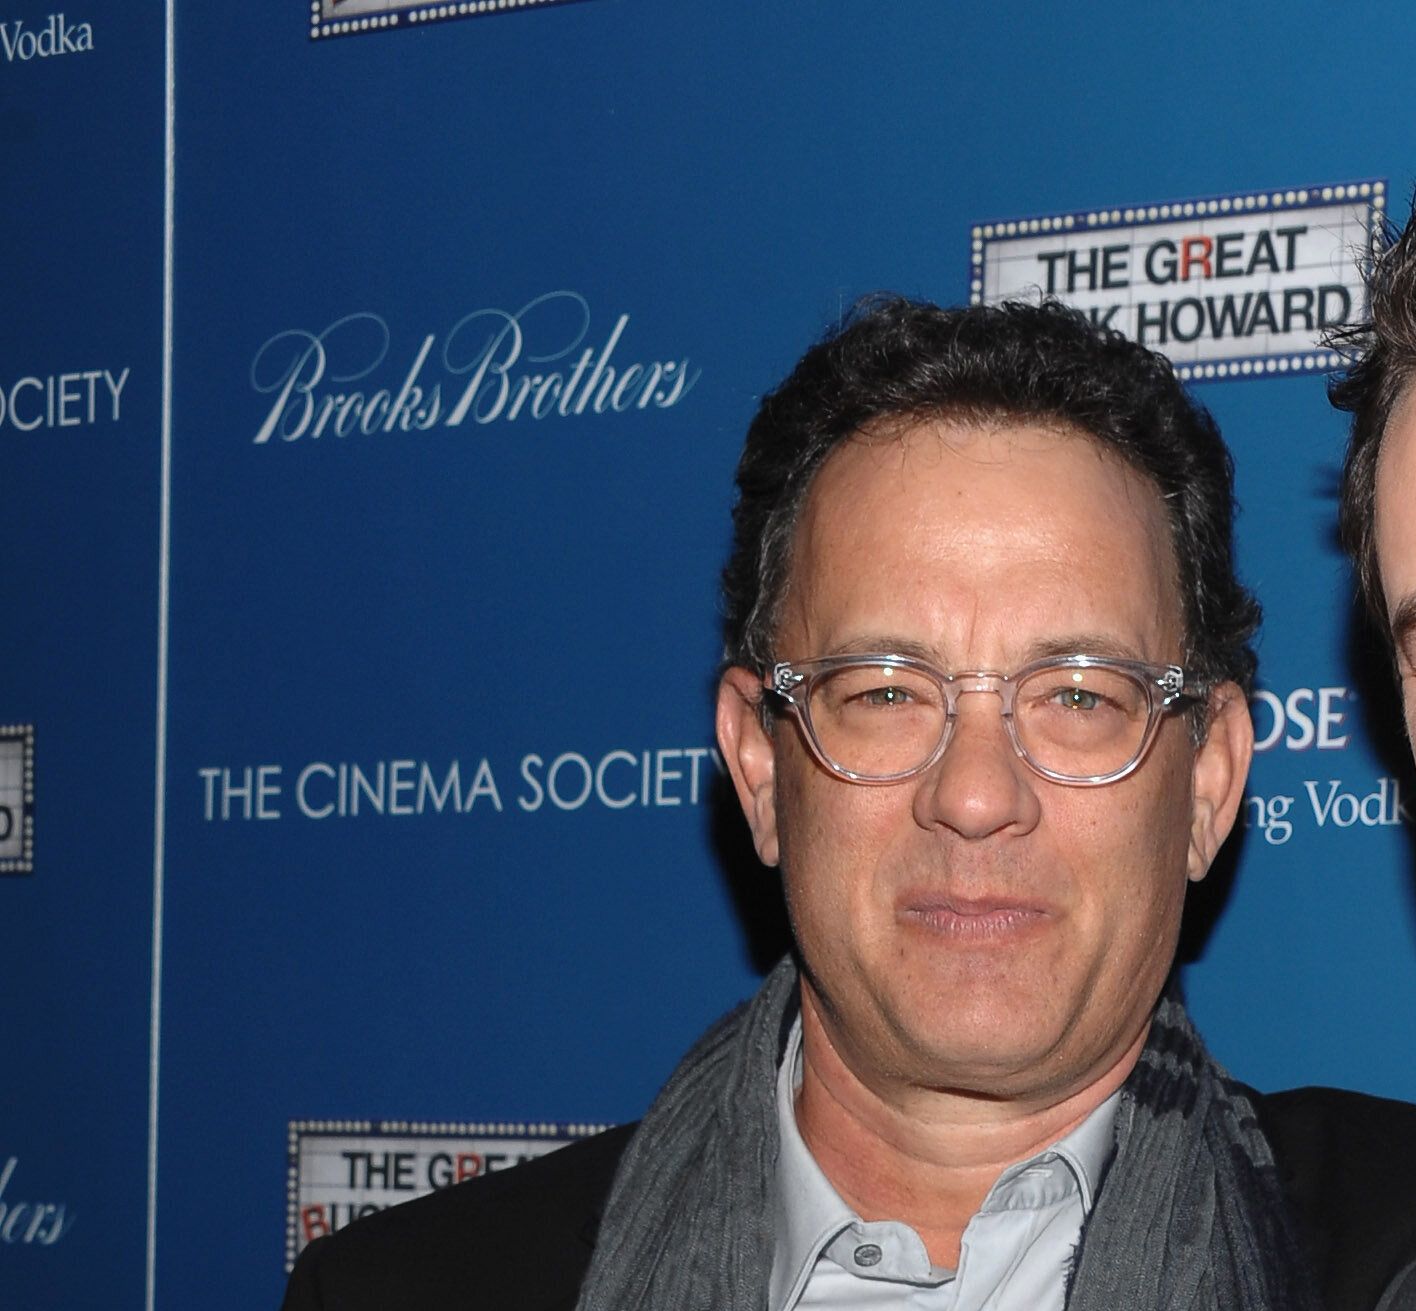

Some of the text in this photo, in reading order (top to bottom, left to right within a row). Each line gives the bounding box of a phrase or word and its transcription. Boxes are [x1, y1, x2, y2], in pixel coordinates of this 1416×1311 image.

[0, 12, 94, 62] Vodka
[1037, 225, 1308, 295] THE GREAT
[1137, 284, 1352, 345] HOWARD
[0, 367, 131, 431] CIETY
[250, 290, 701, 444] Brooks Brothers
[198, 765, 283, 821] THE
[296, 757, 504, 820] CINEMA
[342, 1152, 415, 1190] THE
